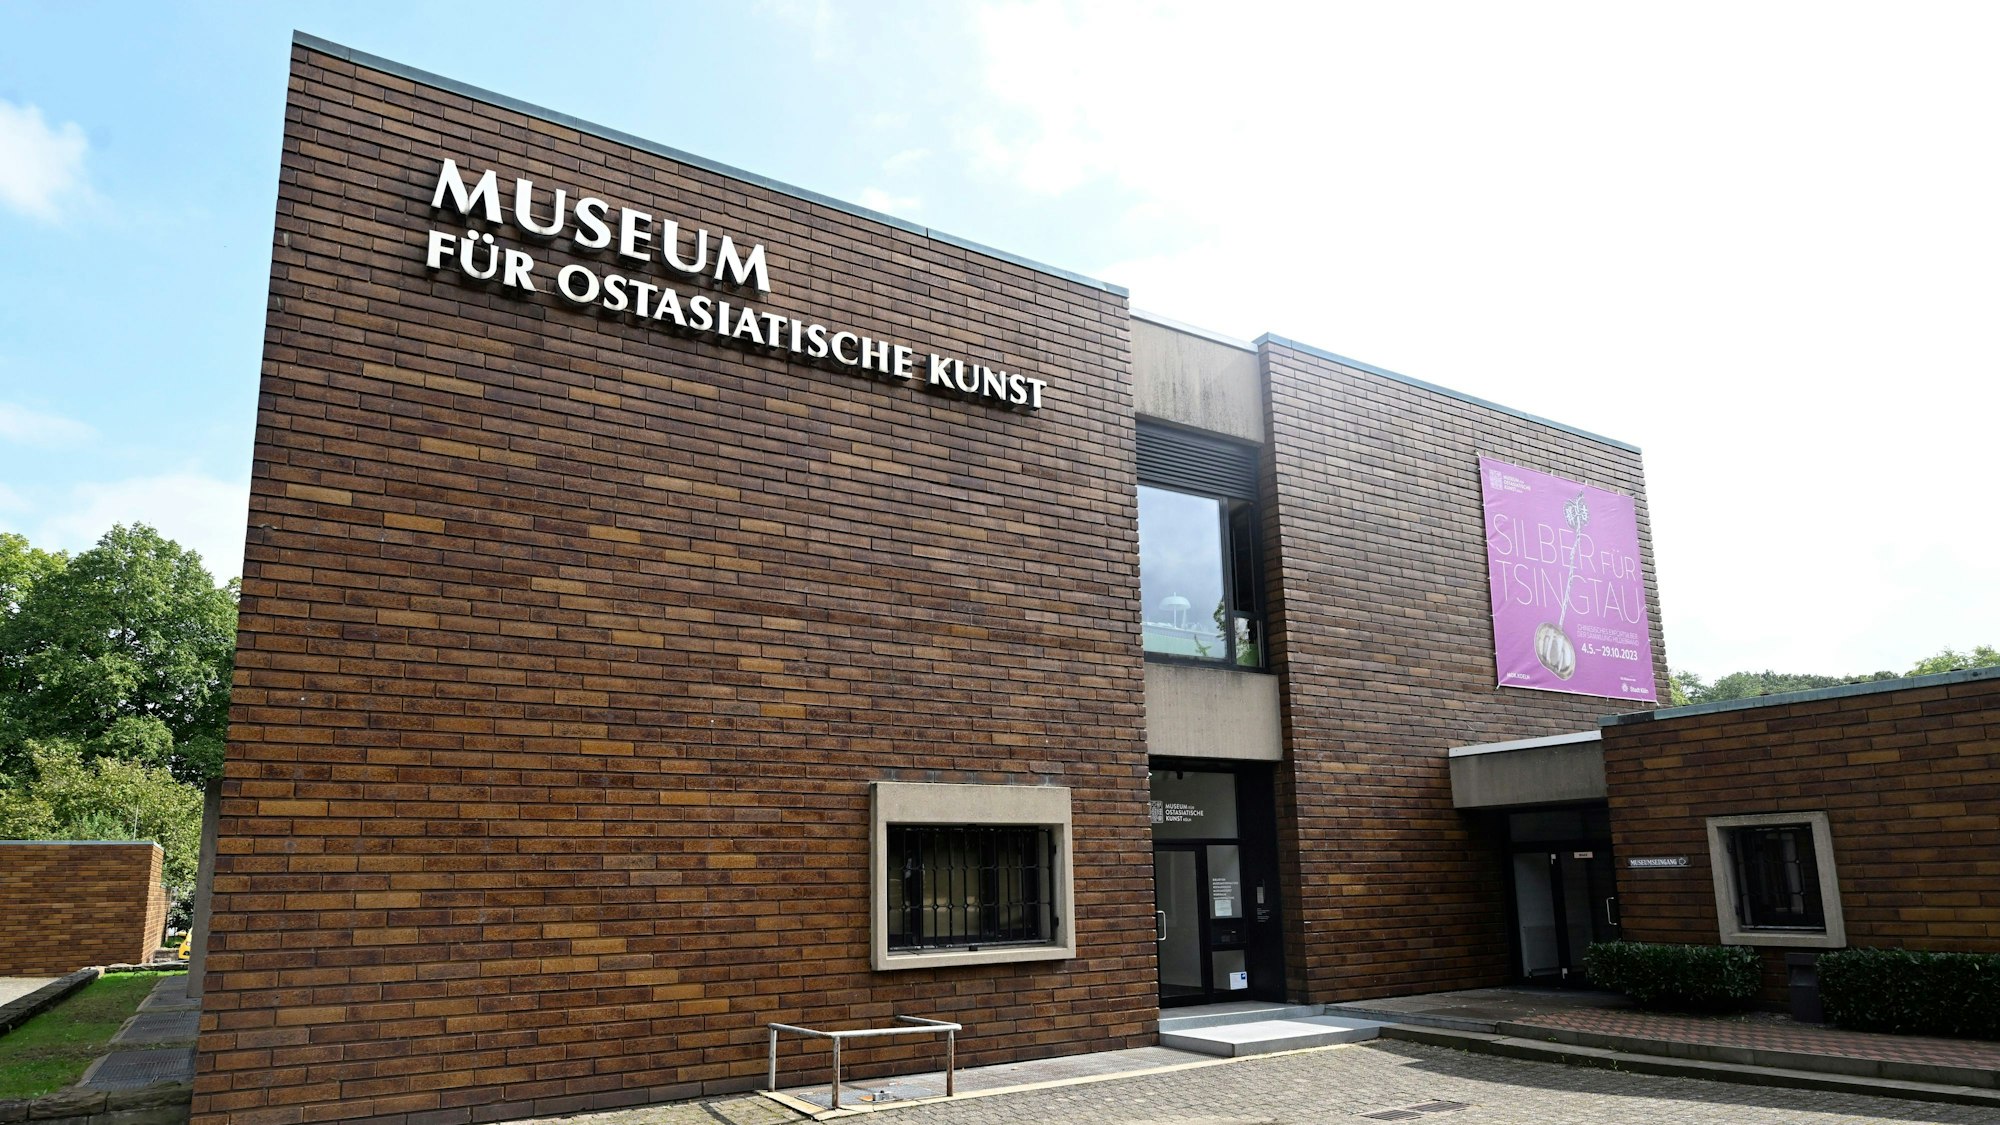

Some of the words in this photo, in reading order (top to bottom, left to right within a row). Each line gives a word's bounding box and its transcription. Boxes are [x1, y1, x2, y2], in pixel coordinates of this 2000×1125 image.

[430, 157, 772, 293] MUSEUM
[426, 229, 537, 294] FÜR
[557, 263, 914, 380] OSTASIATISCHE
[928, 353, 1048, 411] KUNST
[1493, 513, 1595, 570] SILBER
[1601, 549, 1637, 582] FÜR
[1495, 559, 1642, 624] TSINGTAU
